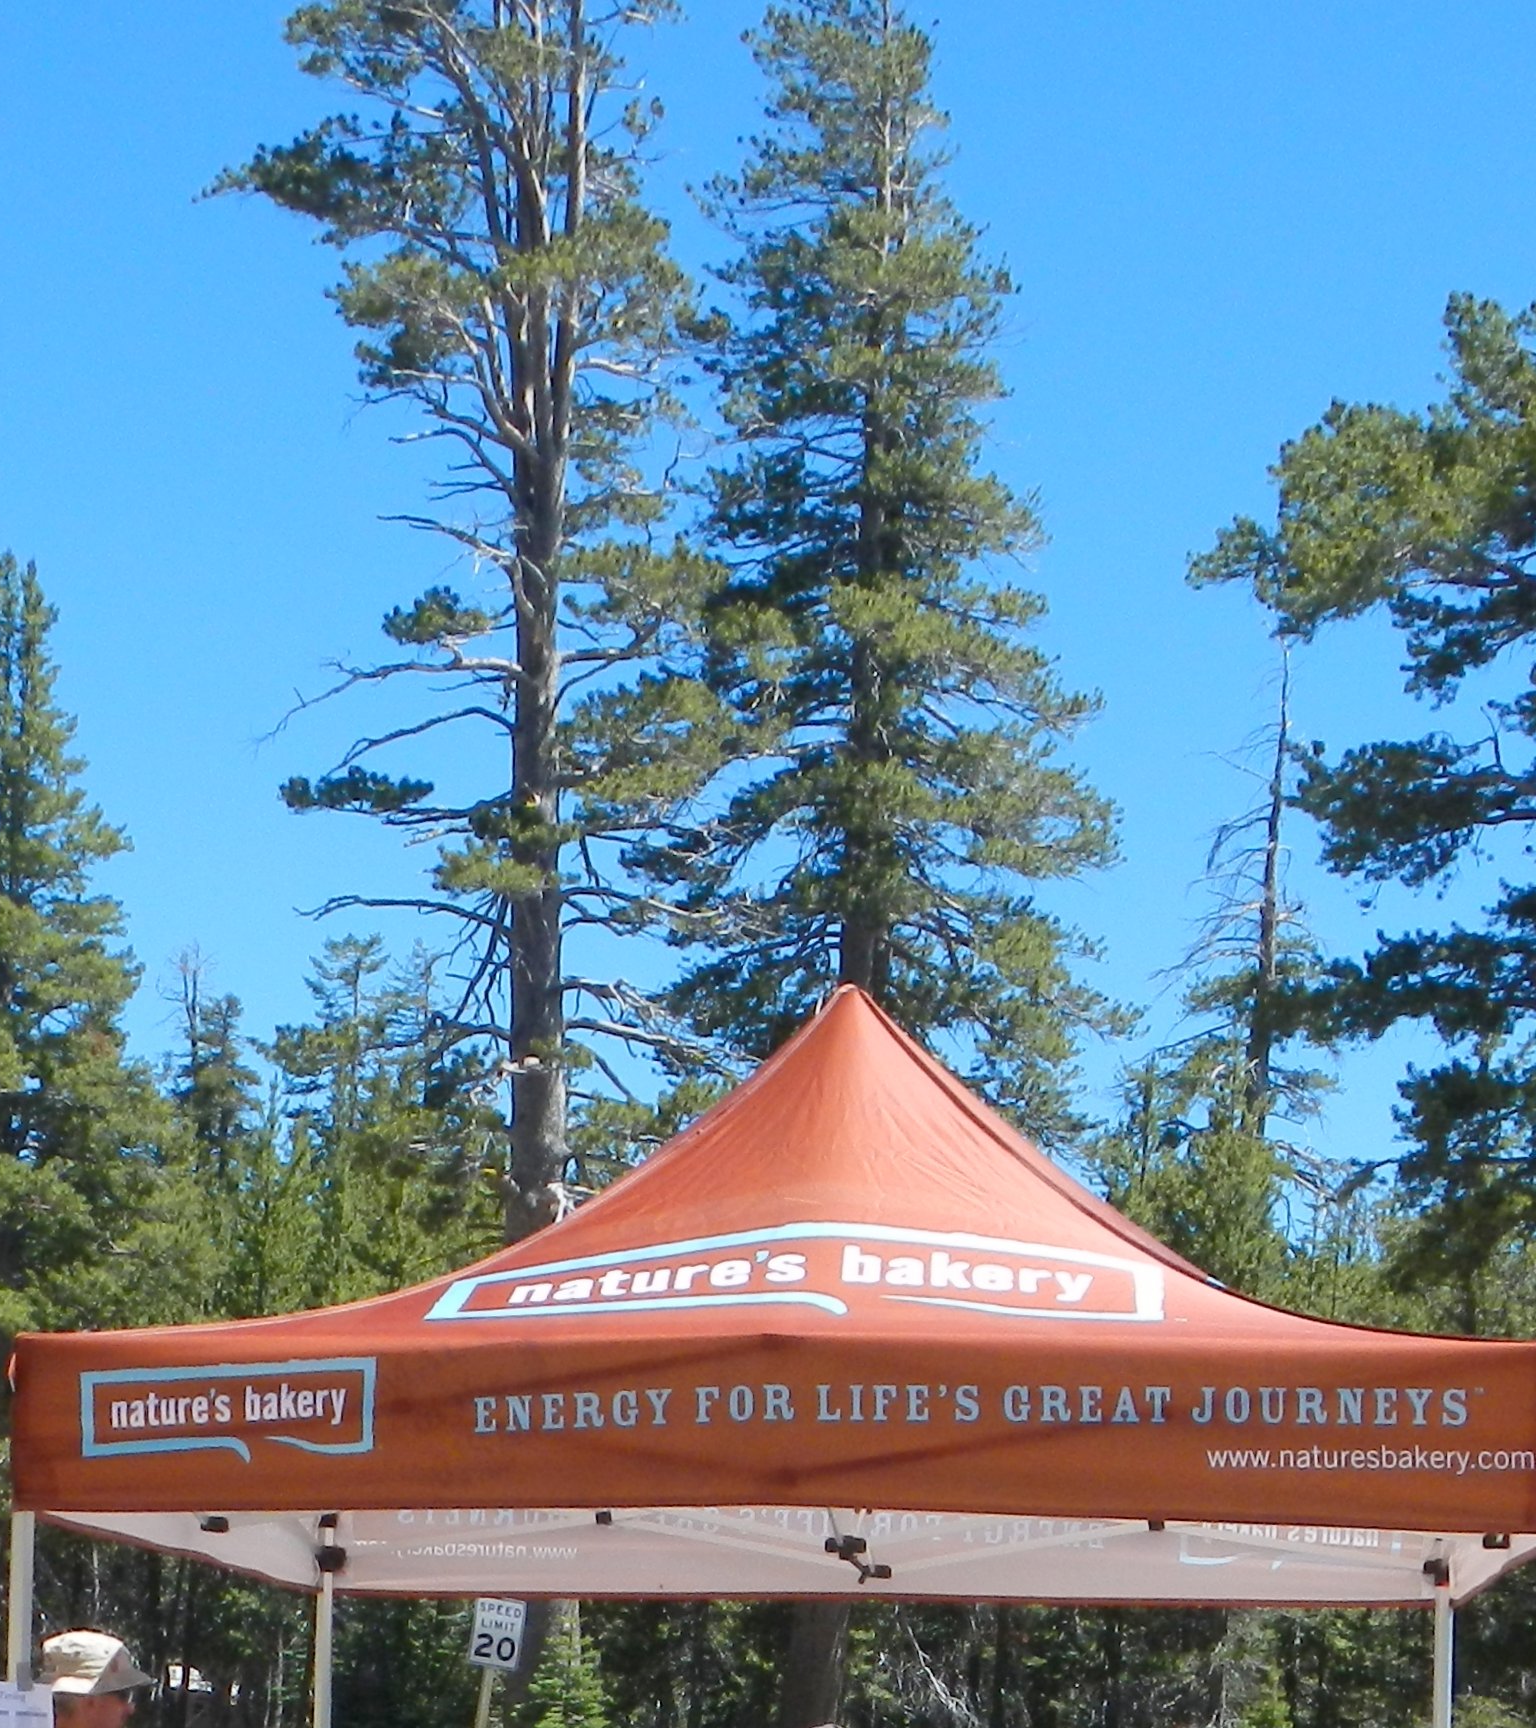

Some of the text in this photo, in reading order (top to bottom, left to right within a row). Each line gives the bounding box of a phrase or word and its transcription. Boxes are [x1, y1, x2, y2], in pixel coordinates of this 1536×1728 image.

[507, 1244, 1094, 1304] nature's bakery
[111, 1383, 347, 1428] nature's bakery
[474, 1383, 1468, 1434] ENERGY FOR LIFE'S GREAT JOURNEYS
[1207, 1445, 1536, 1475] www.naturesbakery.com
[479, 1602, 522, 1618] SPEED
[481, 1618, 516, 1632] LIMIT
[474, 1633, 516, 1662] 20
